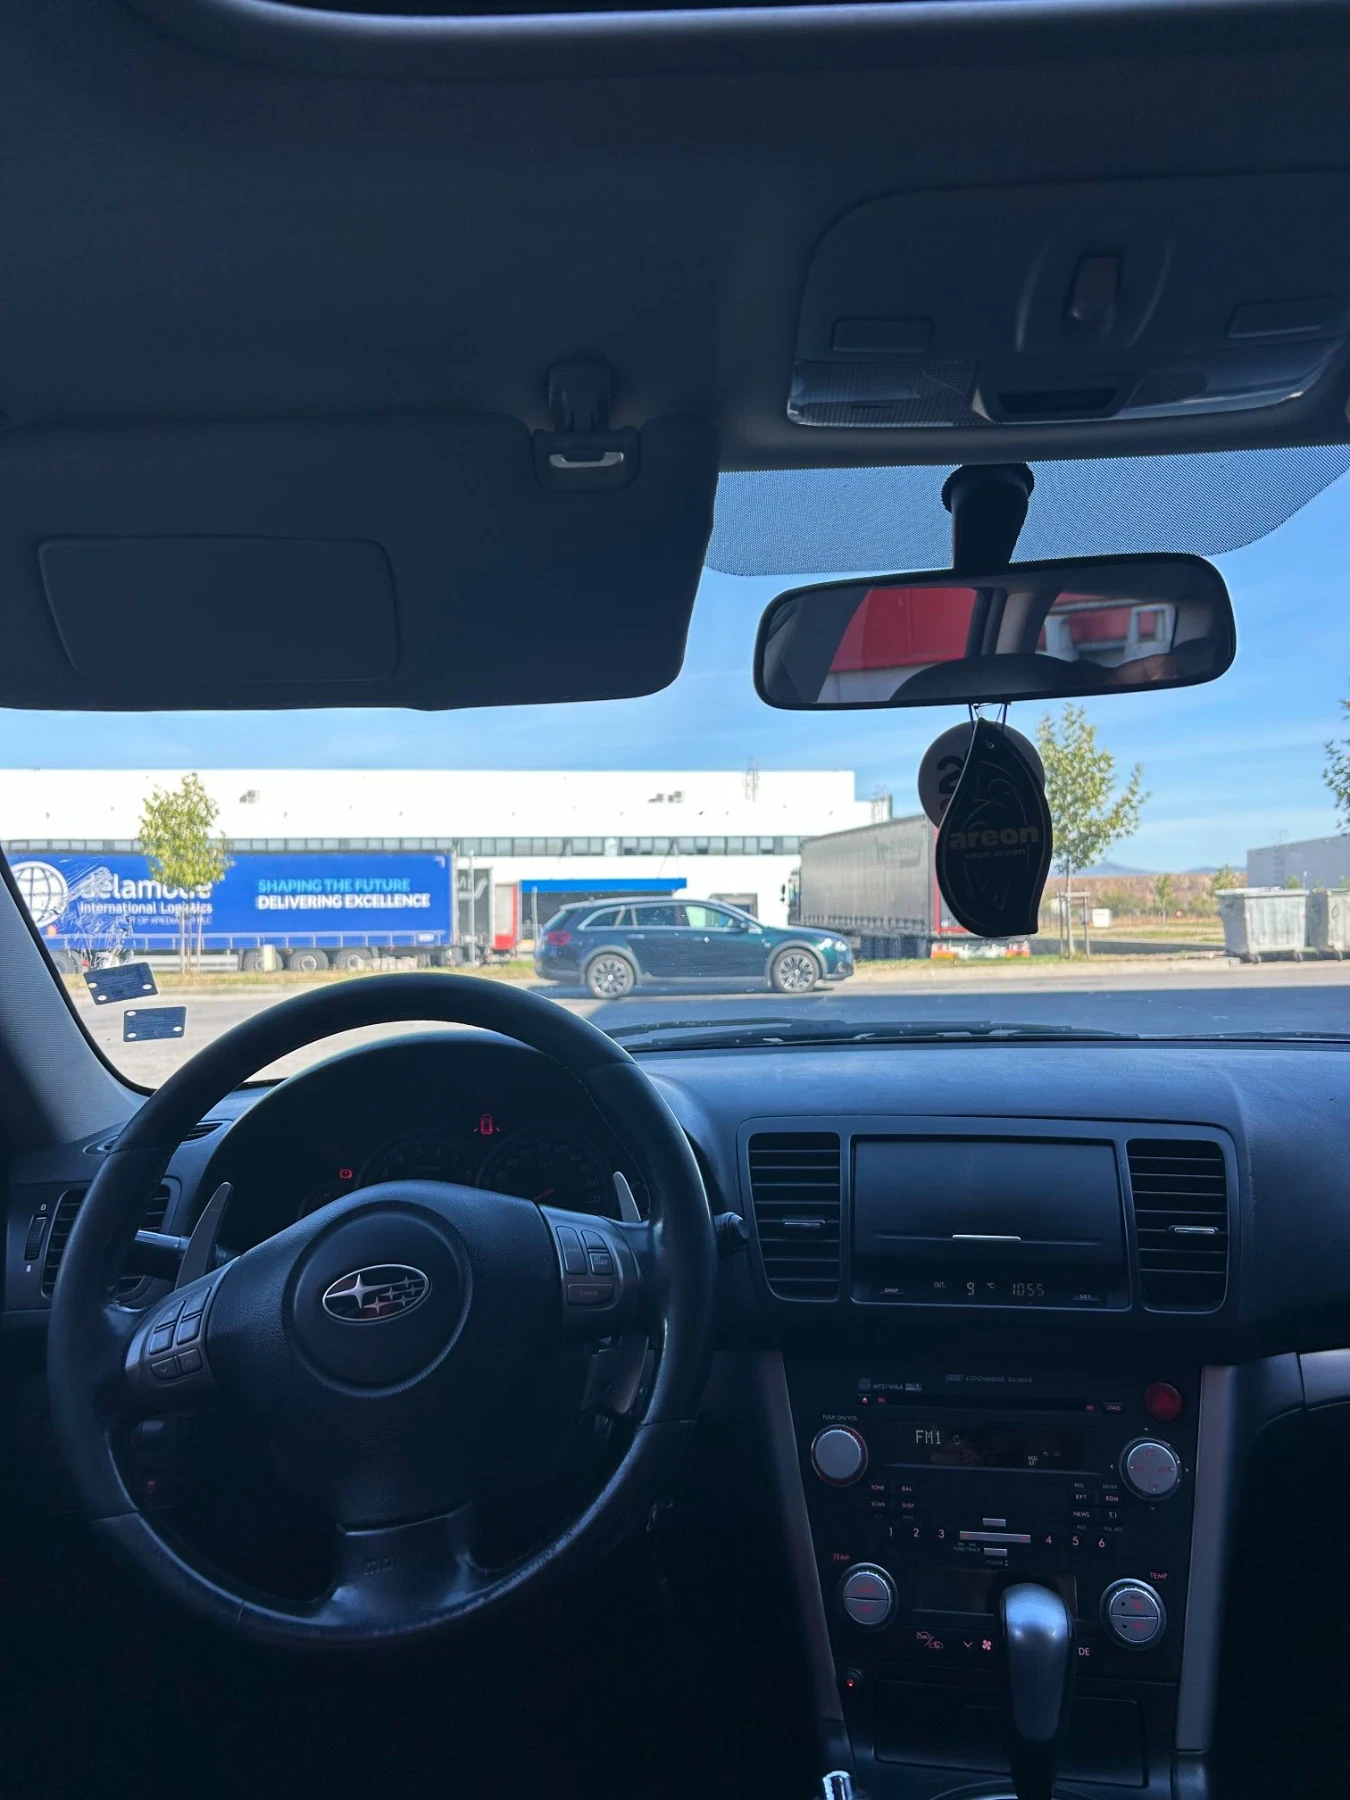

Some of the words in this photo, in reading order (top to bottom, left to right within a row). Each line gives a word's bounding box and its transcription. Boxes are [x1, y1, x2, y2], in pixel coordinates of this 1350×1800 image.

[949, 825, 1040, 849] areon
[257, 878, 322, 893] SHAPING
[324, 878, 353, 892] THE
[355, 877, 411, 892] FUTURE
[257, 894, 342, 910] DELIVERING
[344, 893, 431, 908] EXCELLENCE
[80, 901, 157, 915] International
[966, 1282, 976, 1296] 9
[915, 1429, 942, 1445] FM1
[888, 1526, 894, 1538] 1
[912, 1528, 920, 1539] 2
[938, 1529, 946, 1540] 3
[1045, 1535, 1053, 1545] 4
[1072, 1536, 1080, 1547] 5
[1098, 1538, 1106, 1549] 6
[832, 1552, 850, 1561] TEMP
[1150, 1571, 1168, 1580] TEMP
